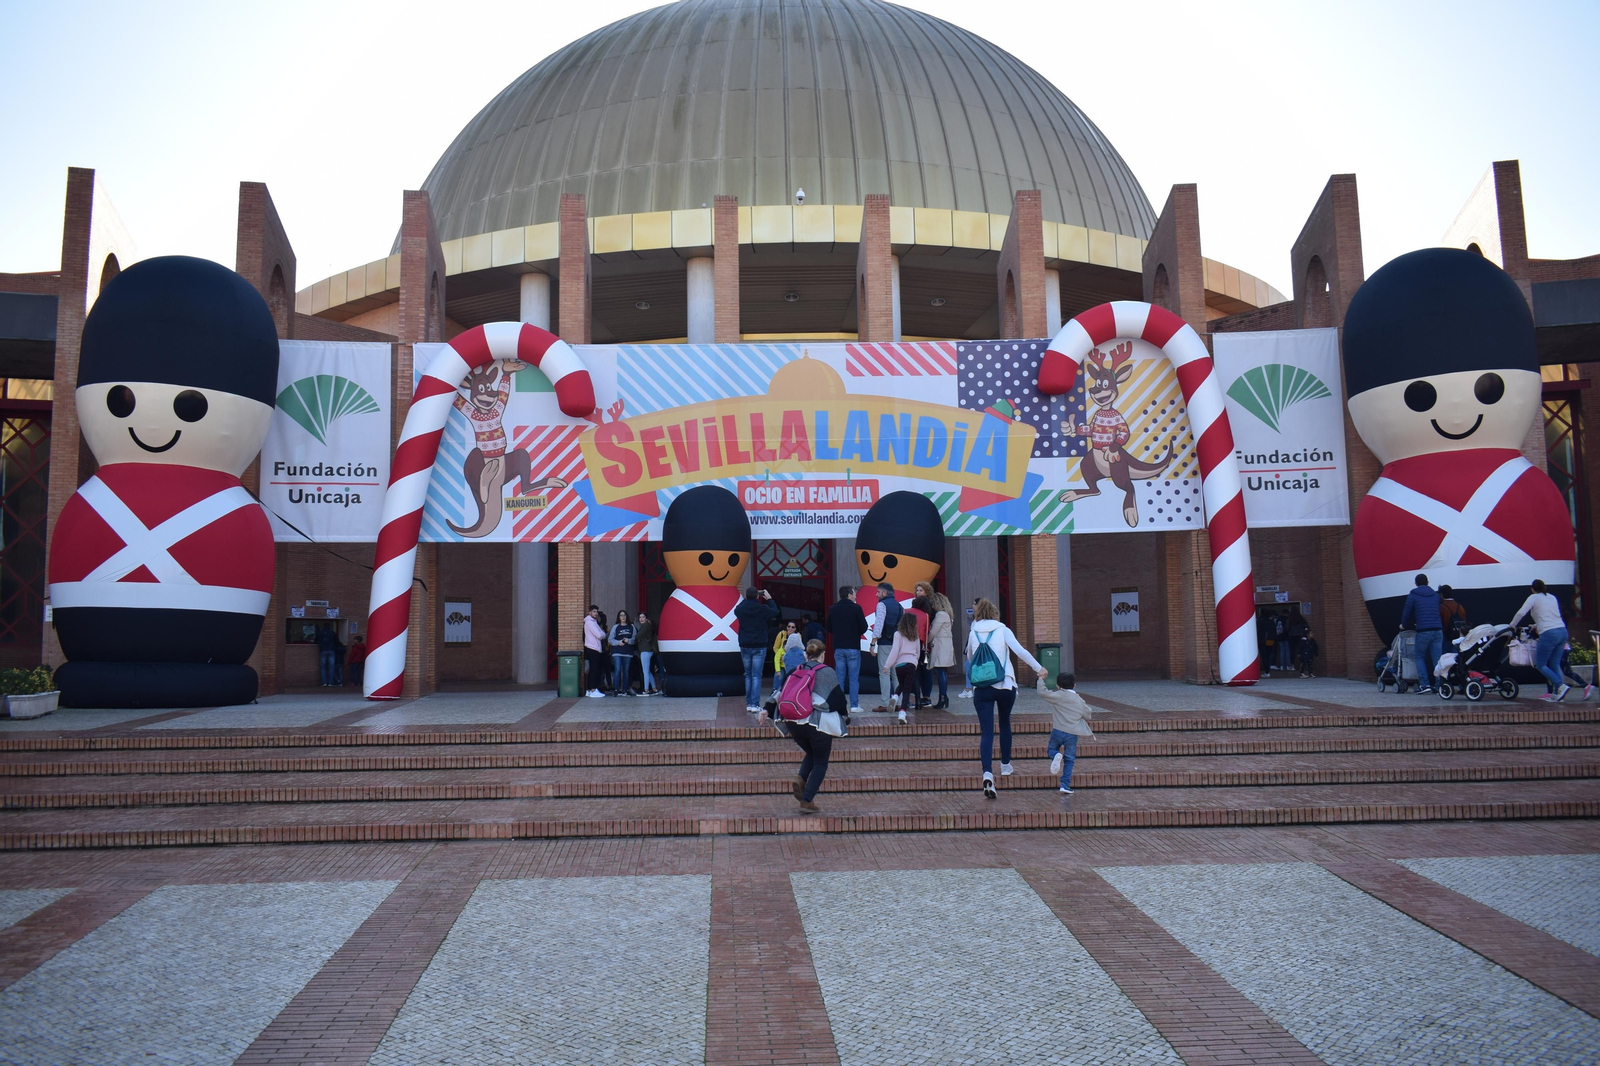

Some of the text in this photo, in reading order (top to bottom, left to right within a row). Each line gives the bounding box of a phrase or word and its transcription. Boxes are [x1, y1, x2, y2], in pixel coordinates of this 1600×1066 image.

[274, 461, 378, 477] Fundación
[1247, 472, 1320, 493] Unicaja
[288, 486, 362, 508] Unicaja
[506, 498, 541, 508] KANGURIN
[744, 485, 873, 505] OCIO EN FAMILIA
